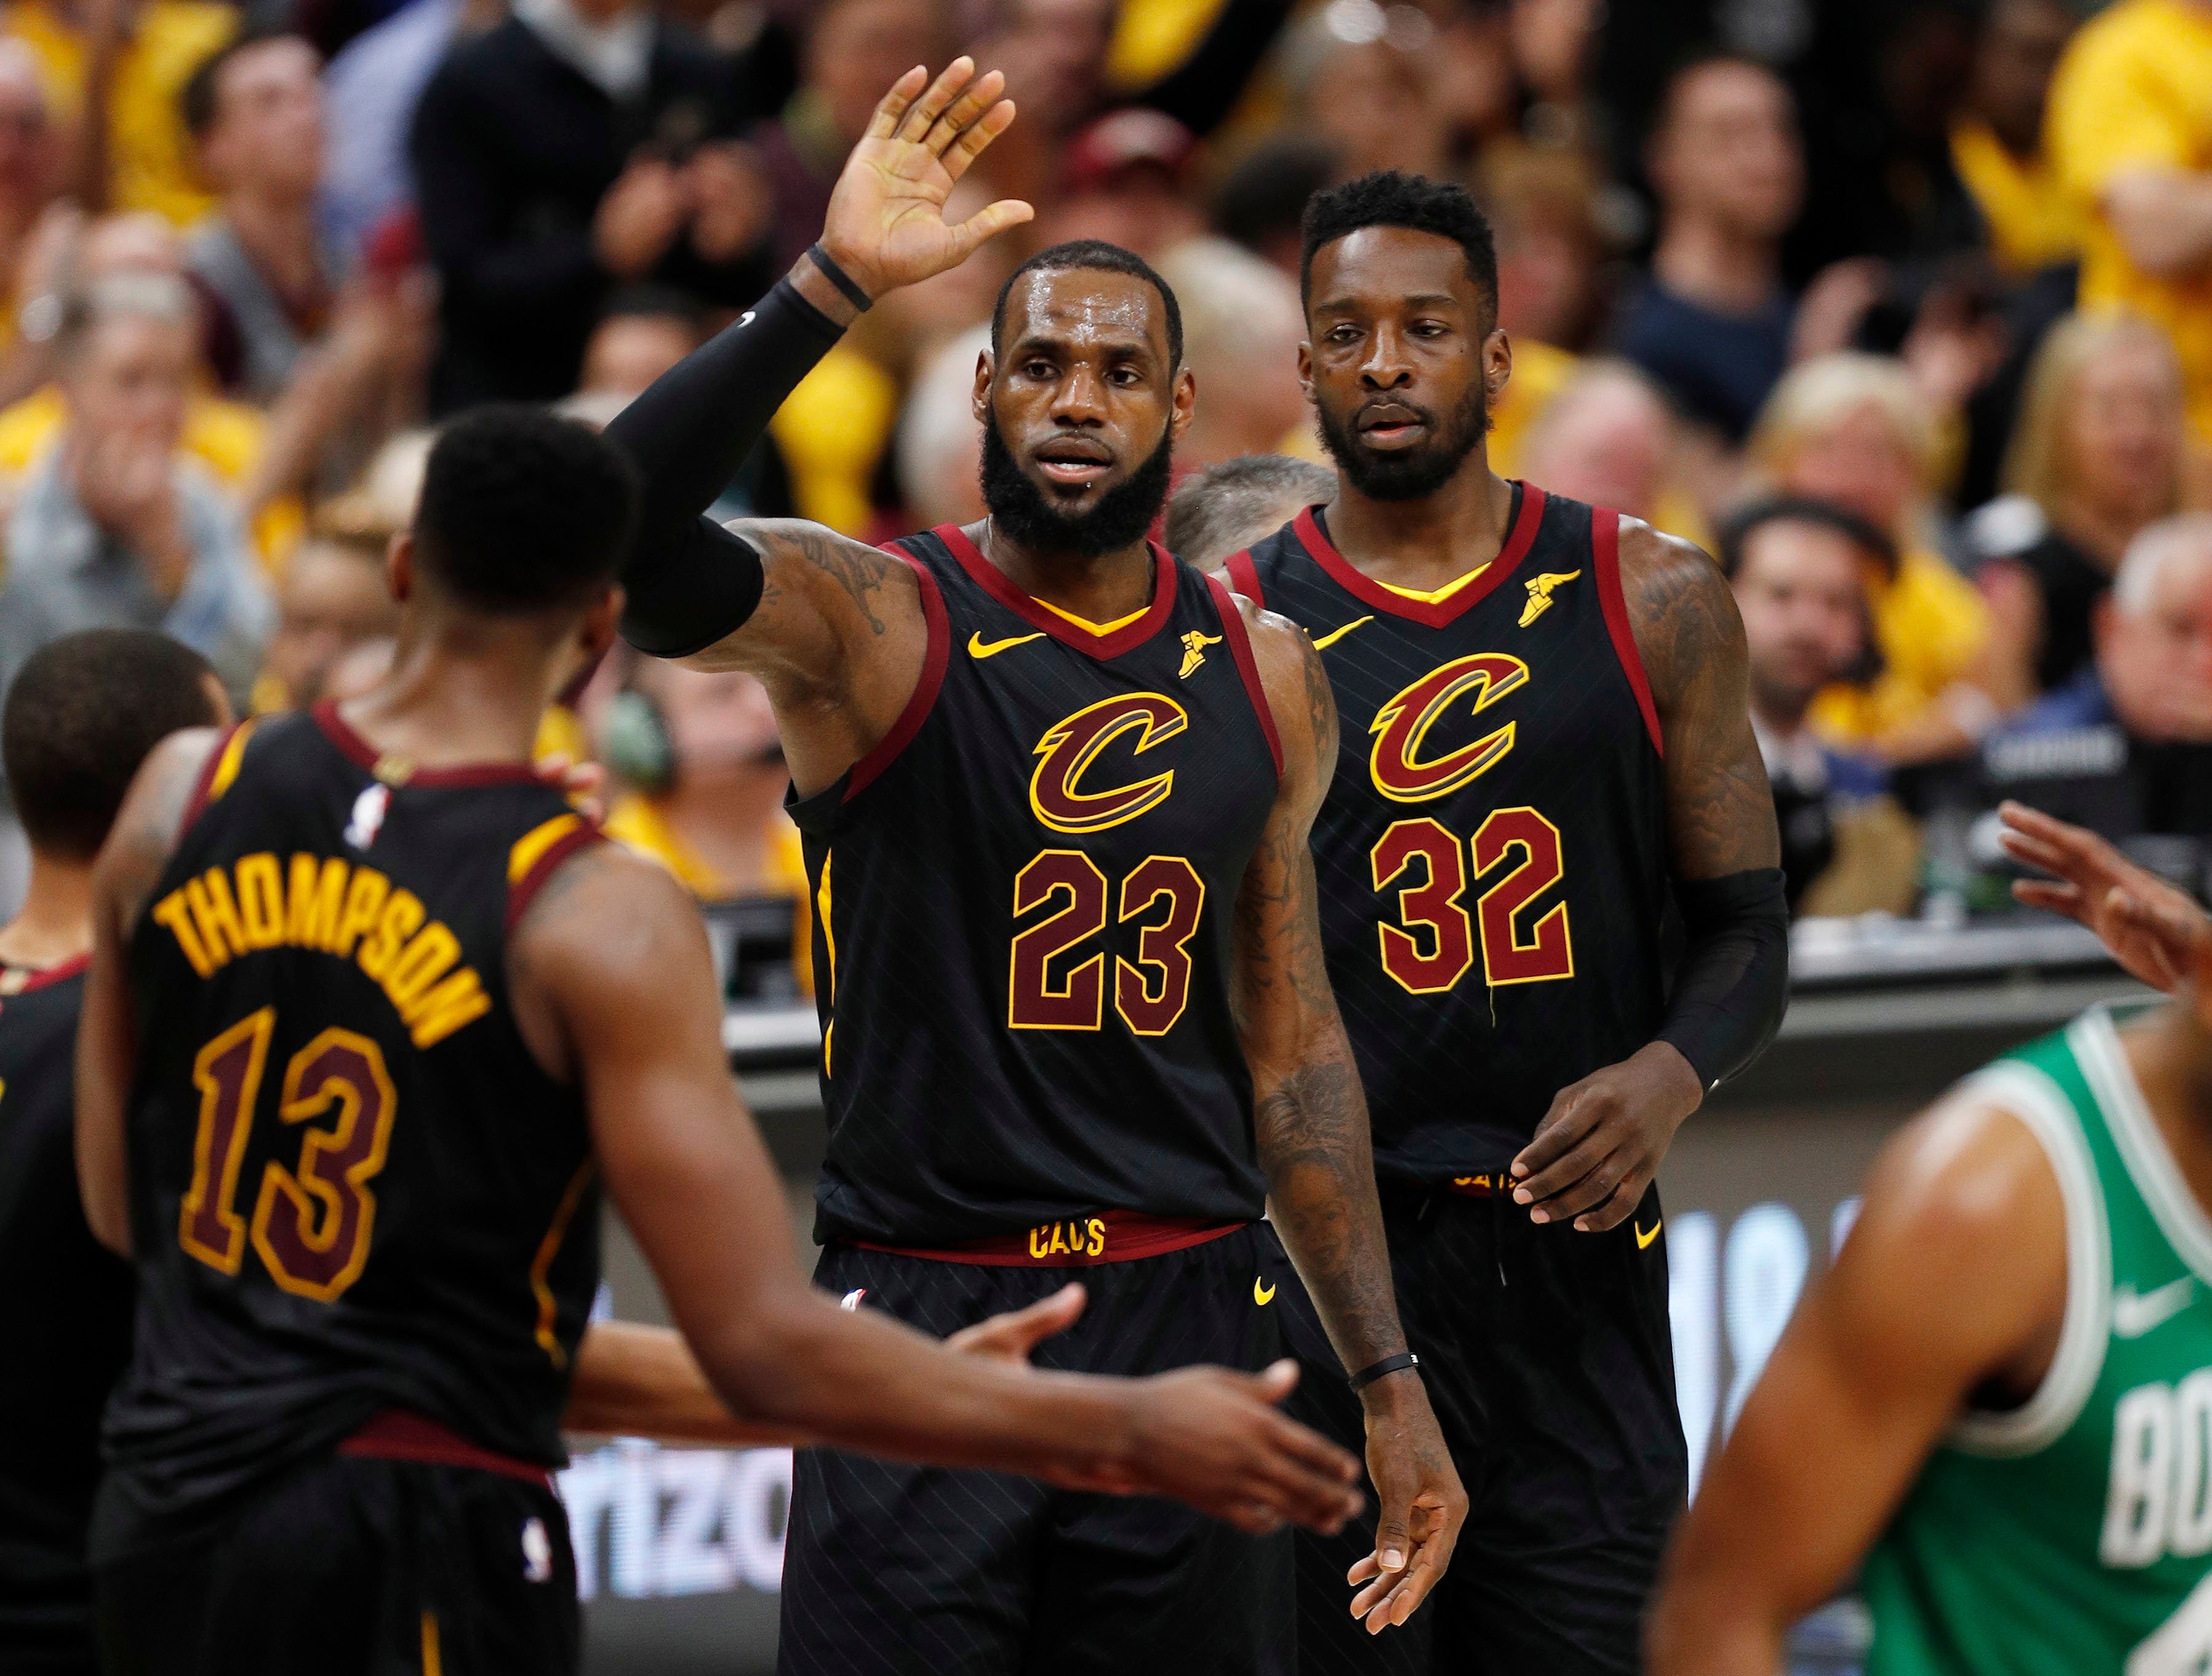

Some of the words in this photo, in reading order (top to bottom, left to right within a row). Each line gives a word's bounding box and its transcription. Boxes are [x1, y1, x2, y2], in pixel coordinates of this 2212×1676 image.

[1029, 692, 1188, 833] C
[1368, 652, 1529, 802] C
[152, 850, 493, 1049] THOMPSON
[1008, 849, 1205, 1036] 23
[1370, 806, 1574, 995] 32
[178, 1004, 398, 1304] 13
